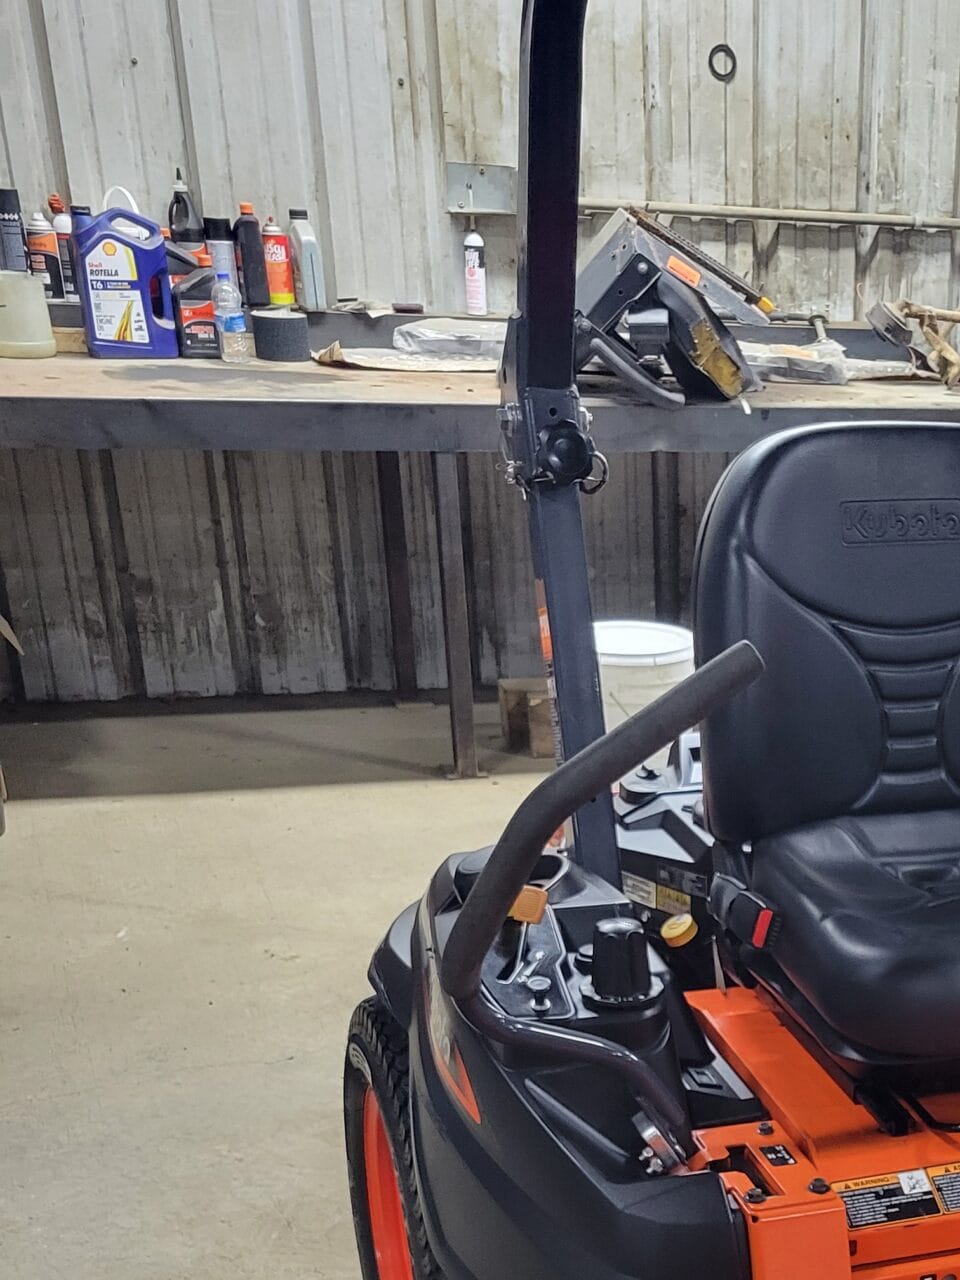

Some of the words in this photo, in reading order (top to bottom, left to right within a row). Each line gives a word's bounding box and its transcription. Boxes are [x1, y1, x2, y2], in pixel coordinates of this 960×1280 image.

[90, 269, 119, 277] ROTELLA
[92, 281, 104, 289] T6
[852, 1176, 890, 1189] WARNING
